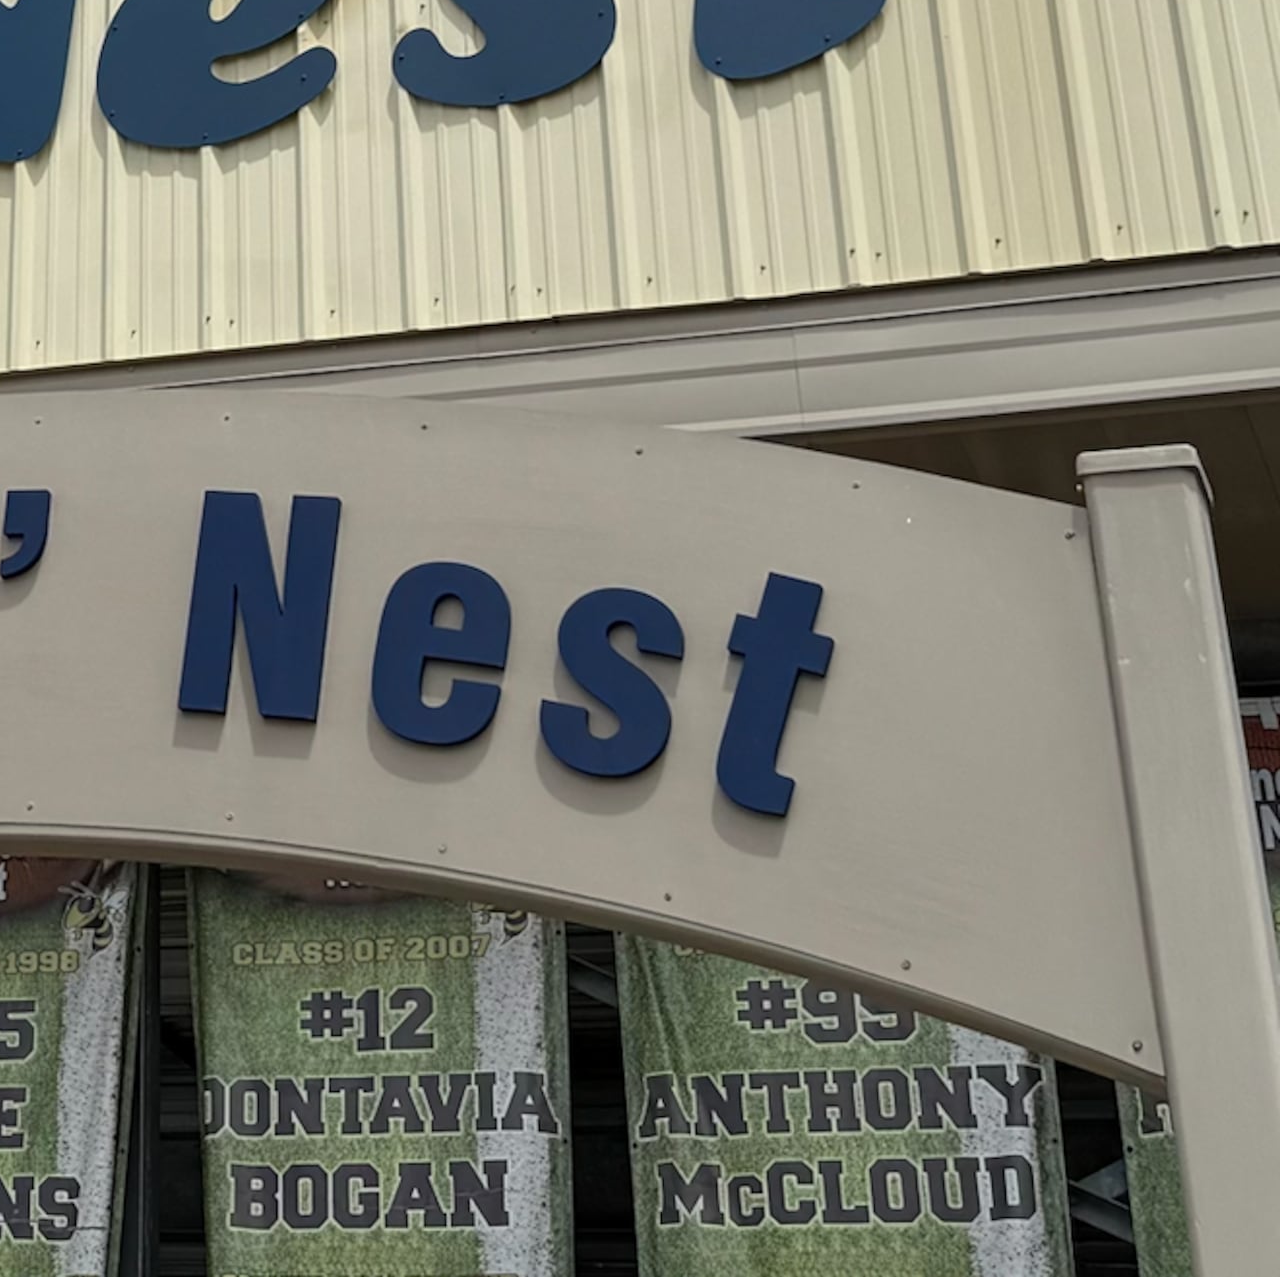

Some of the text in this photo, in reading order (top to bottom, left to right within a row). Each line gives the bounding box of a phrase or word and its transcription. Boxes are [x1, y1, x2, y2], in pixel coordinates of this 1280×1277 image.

[177, 488, 835, 817] Nest
[4, 949, 81, 975] 1998
[232, 932, 492, 967] CLASS OF 2007
[298, 985, 436, 1053] #12
[638, 1063, 1043, 1142] ANTHONY
[228, 1159, 511, 1231] BOGAN
[657, 1154, 1040, 1227] McCLOUD
